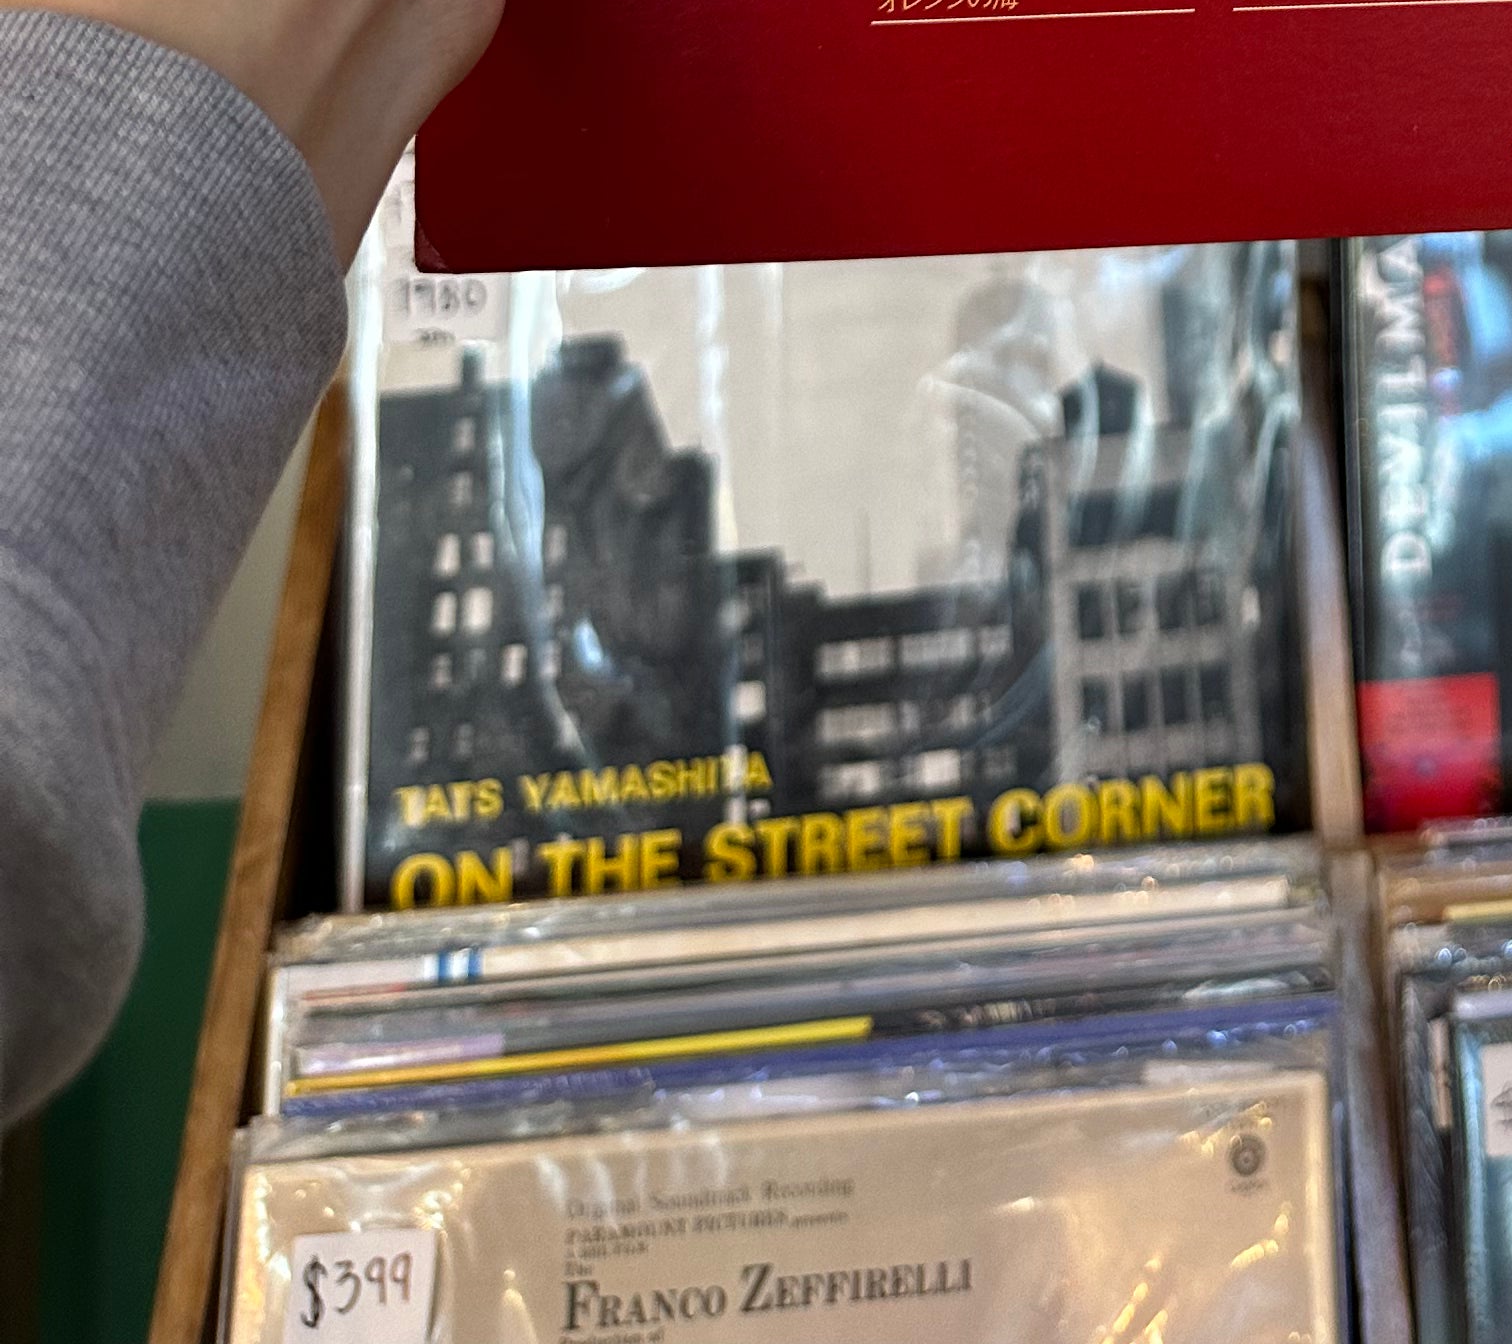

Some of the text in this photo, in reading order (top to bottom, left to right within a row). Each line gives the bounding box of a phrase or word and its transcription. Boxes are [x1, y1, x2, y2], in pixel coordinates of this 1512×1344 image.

[389, 762, 1276, 912] ON THE STREET CORNER
[394, 777, 504, 827] TATS
[300, 1252, 414, 1329] $399
[562, 1258, 975, 1332] FRANCO ZEFFIRELLI
